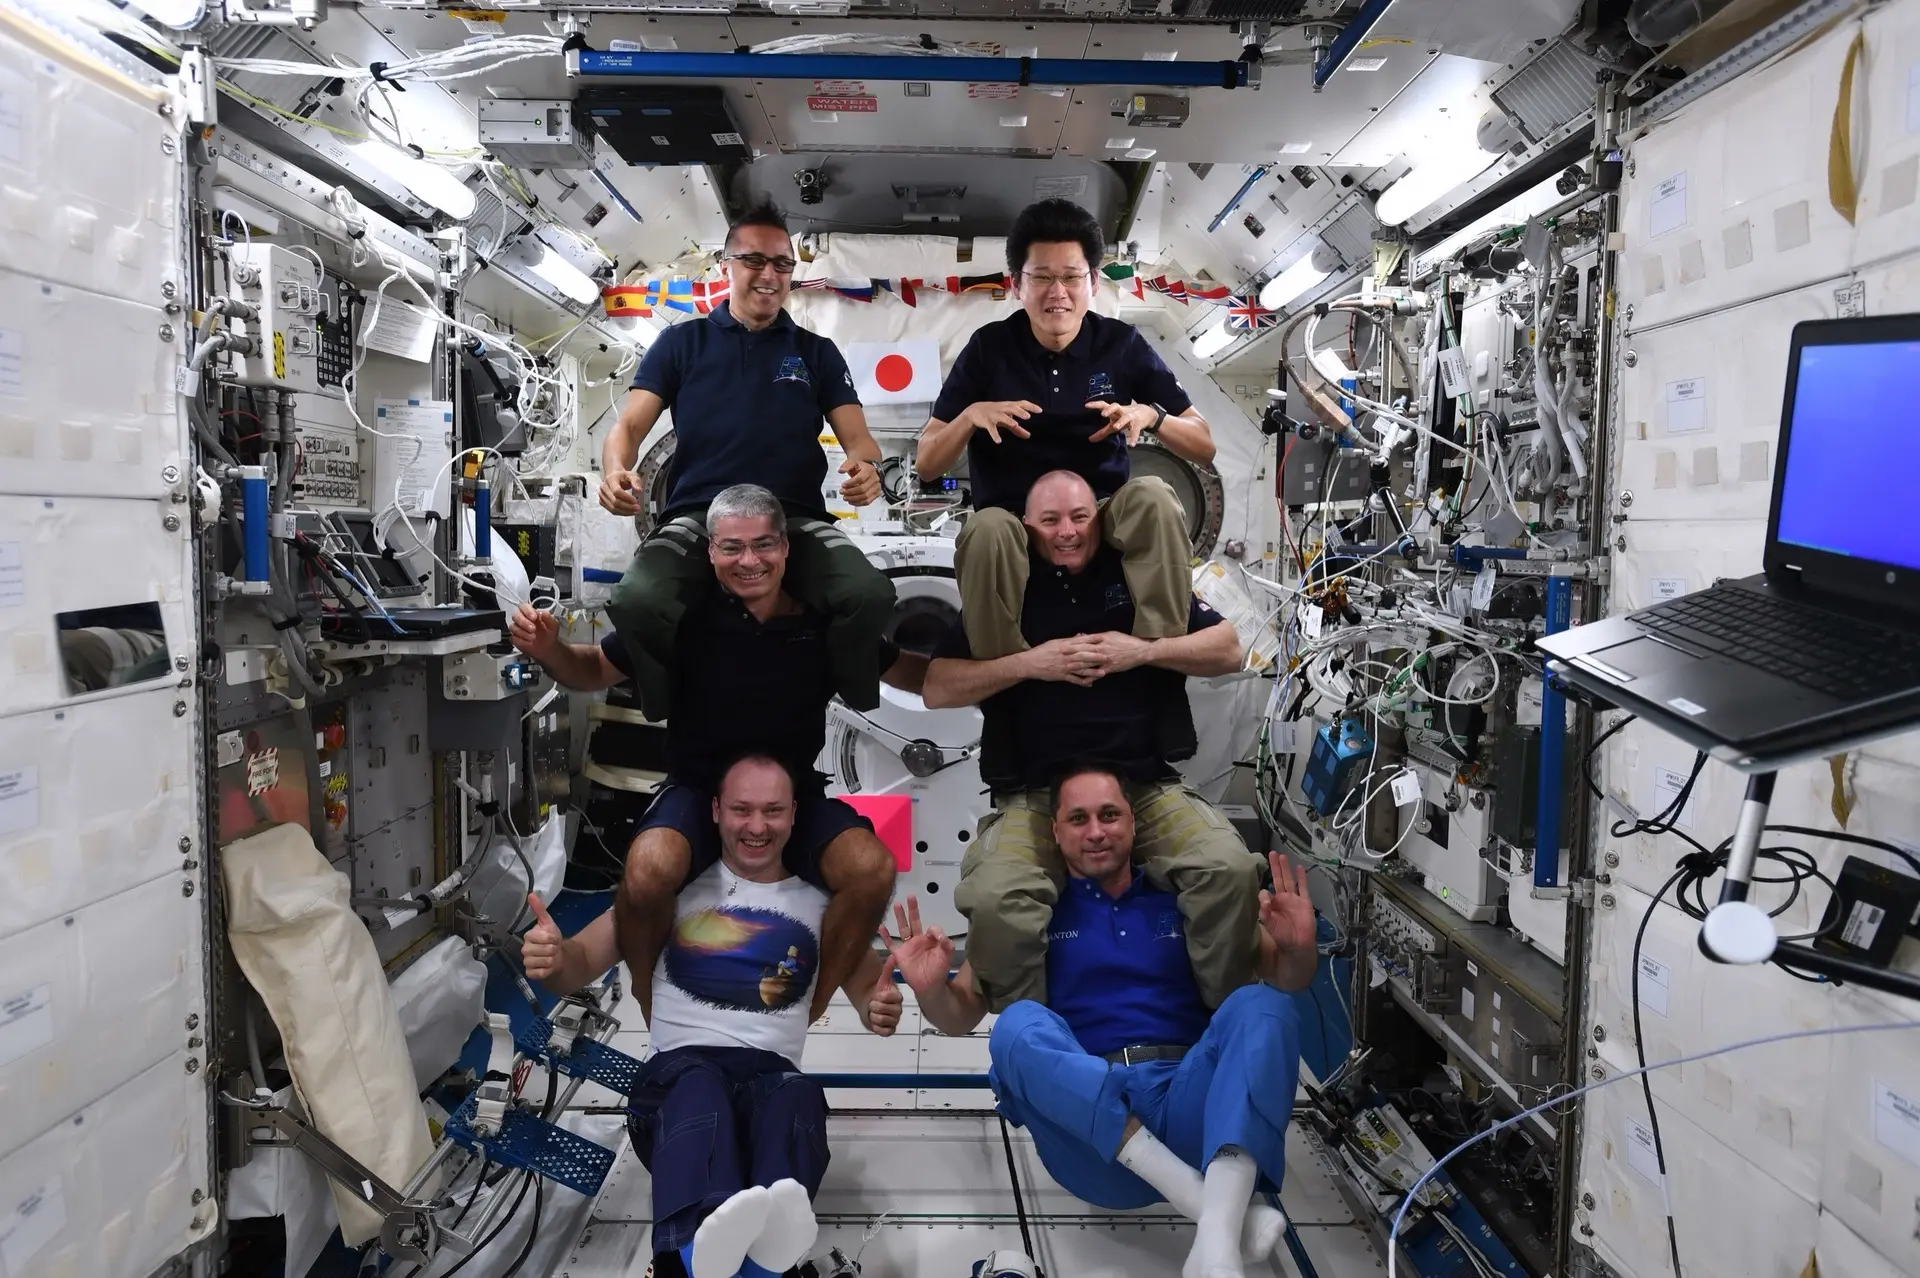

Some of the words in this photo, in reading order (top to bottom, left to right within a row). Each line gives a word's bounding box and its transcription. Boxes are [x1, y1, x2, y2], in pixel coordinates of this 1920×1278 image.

[252, 769, 263, 778] FIRE
[263, 765, 275, 775] PORT
[1049, 930, 1079, 941] ANTON
